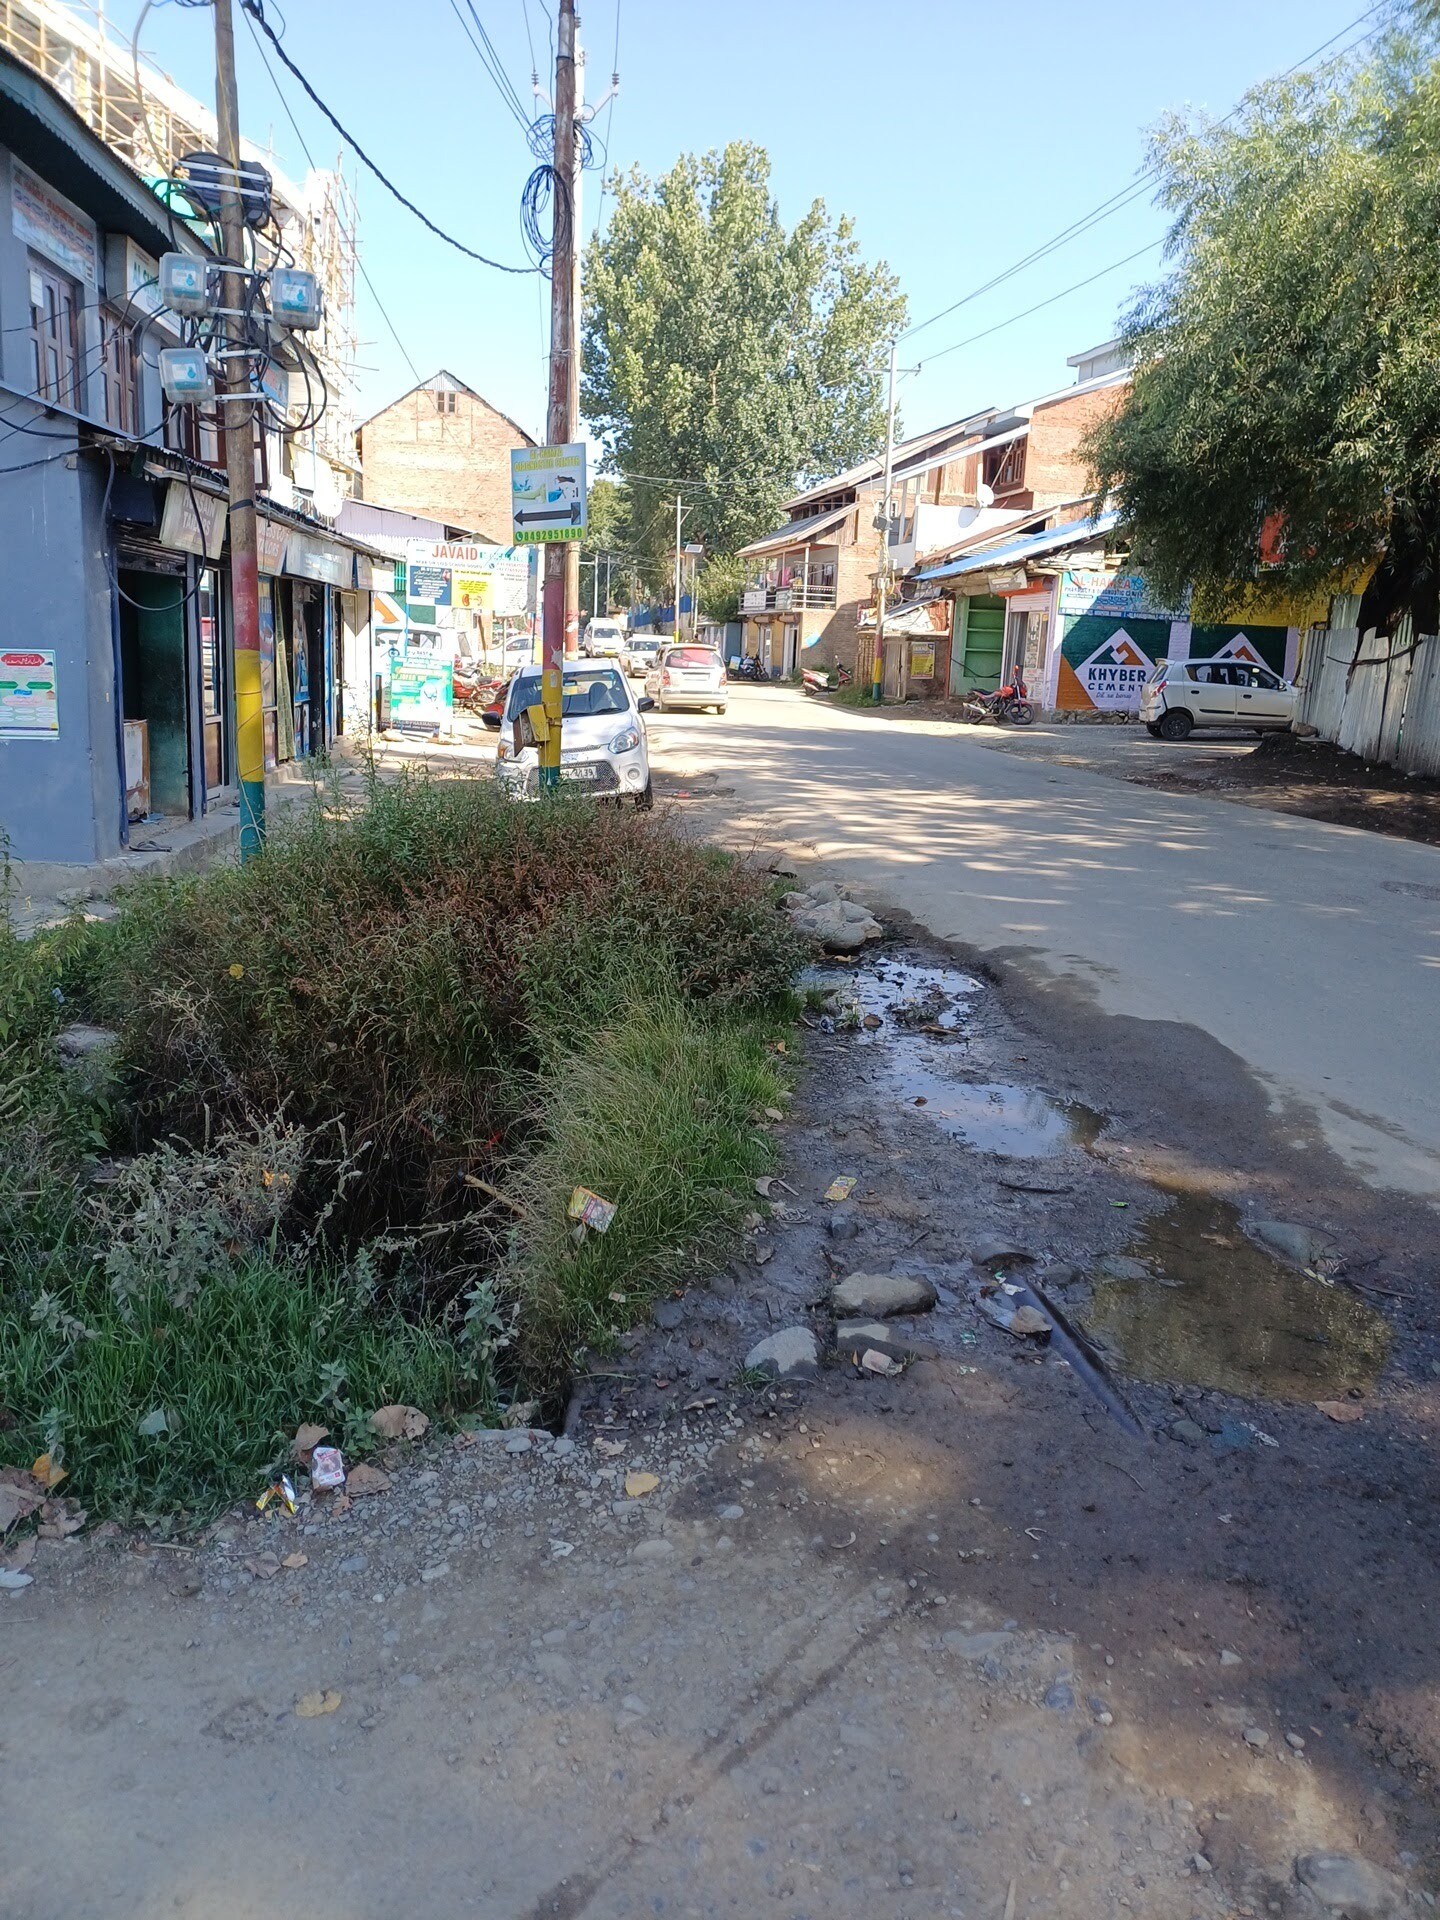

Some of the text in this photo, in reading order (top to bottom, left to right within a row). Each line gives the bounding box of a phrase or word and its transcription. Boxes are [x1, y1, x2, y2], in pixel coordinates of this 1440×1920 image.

[524, 528, 582, 541] 8492951890
[432, 544, 478, 560] JAVAID
[1088, 668, 1147, 682] KHYBER
[1088, 683, 1144, 692] CEMENT
